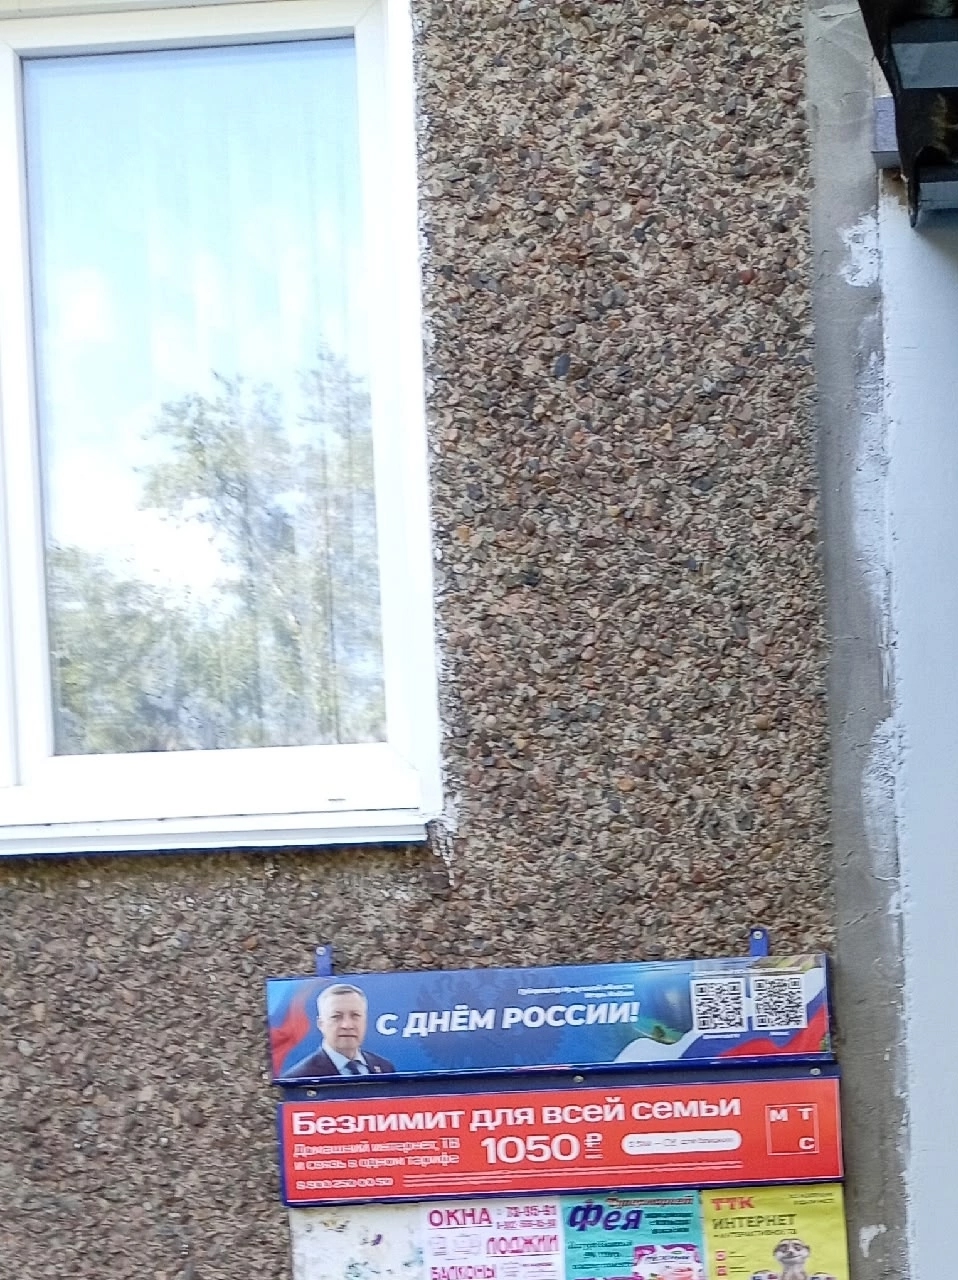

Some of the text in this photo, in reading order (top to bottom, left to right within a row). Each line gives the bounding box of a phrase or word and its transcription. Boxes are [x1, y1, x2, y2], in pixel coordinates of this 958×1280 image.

[376, 1002, 640, 1038] С ДНЁМ РОССИИ!
[291, 1096, 742, 1135] Безлимит для всей семьи
[440, 1137, 460, 1149] ТВ
[481, 1133, 580, 1164] 1050
[711, 1196, 755, 1211] ТТК
[429, 1207, 493, 1227] ОКНА
[567, 1199, 644, 1231] Фея
[712, 1213, 797, 1229] ИНТЕРНЕТ
[486, 1234, 559, 1255] ЛОДЖИИ
